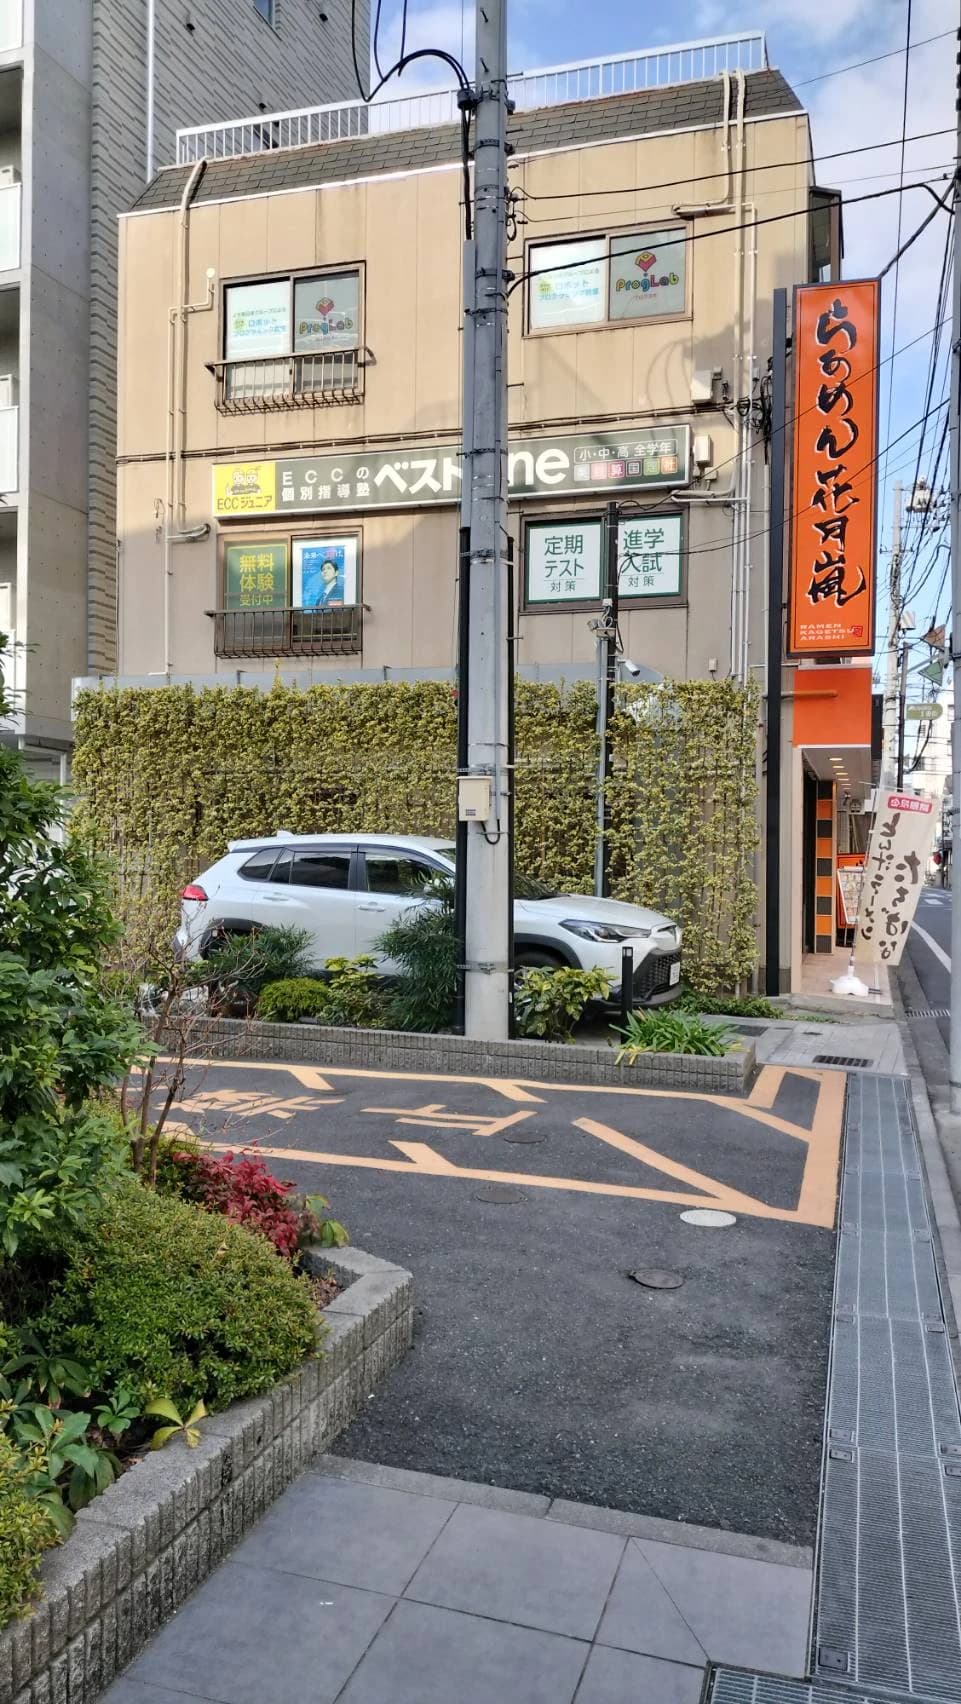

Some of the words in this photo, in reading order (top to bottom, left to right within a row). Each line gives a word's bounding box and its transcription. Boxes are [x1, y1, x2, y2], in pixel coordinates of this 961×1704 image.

[634, 441, 673, 457] 全学年
[281, 483, 370, 502] 個別指導塾
[217, 495, 273, 510] ECCジュニア
[544, 534, 584, 556] 定期
[623, 528, 664, 550] 進学
[239, 552, 274, 573] 無料
[544, 558, 584, 578] テスト
[621, 552, 663, 574] 入試
[239, 573, 274, 593] 体験
[550, 580, 576, 593] 対策
[628, 575, 655, 588] 対策
[239, 593, 273, 607] 受付中
